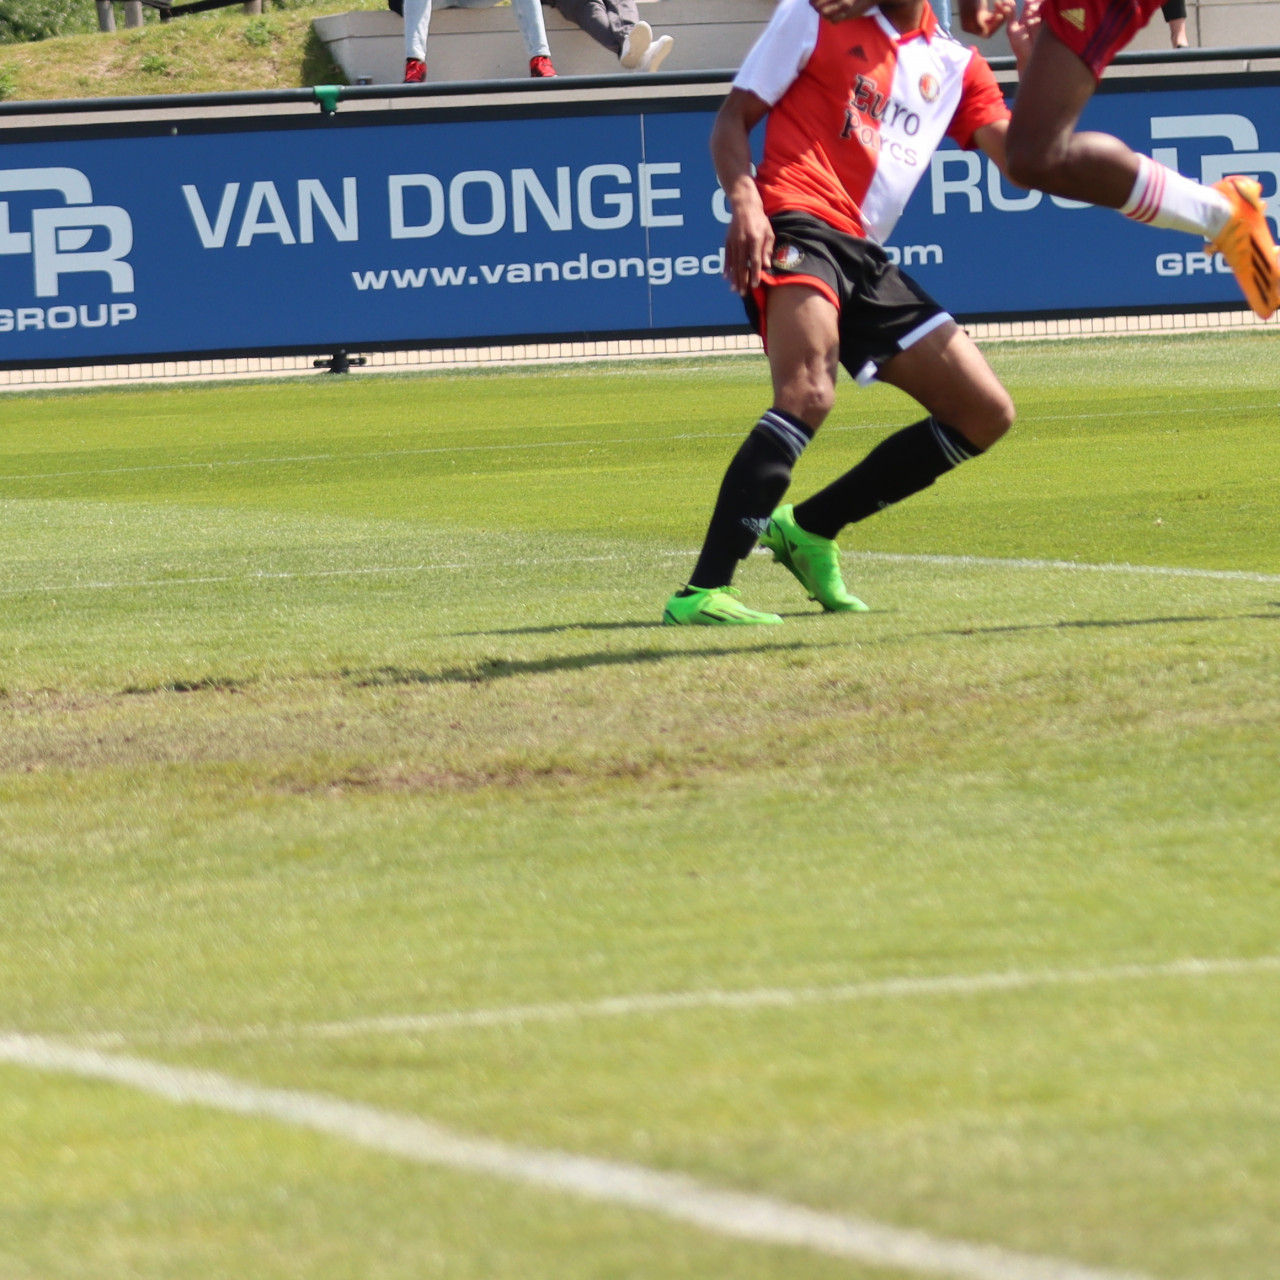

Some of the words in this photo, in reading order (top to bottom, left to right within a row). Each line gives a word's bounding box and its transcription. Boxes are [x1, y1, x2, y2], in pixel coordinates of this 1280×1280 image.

[849, 73, 922, 137] Euro
[839, 108, 918, 168] Parcs
[181, 176, 360, 249] VAN
[388, 161, 684, 239] DONGE
